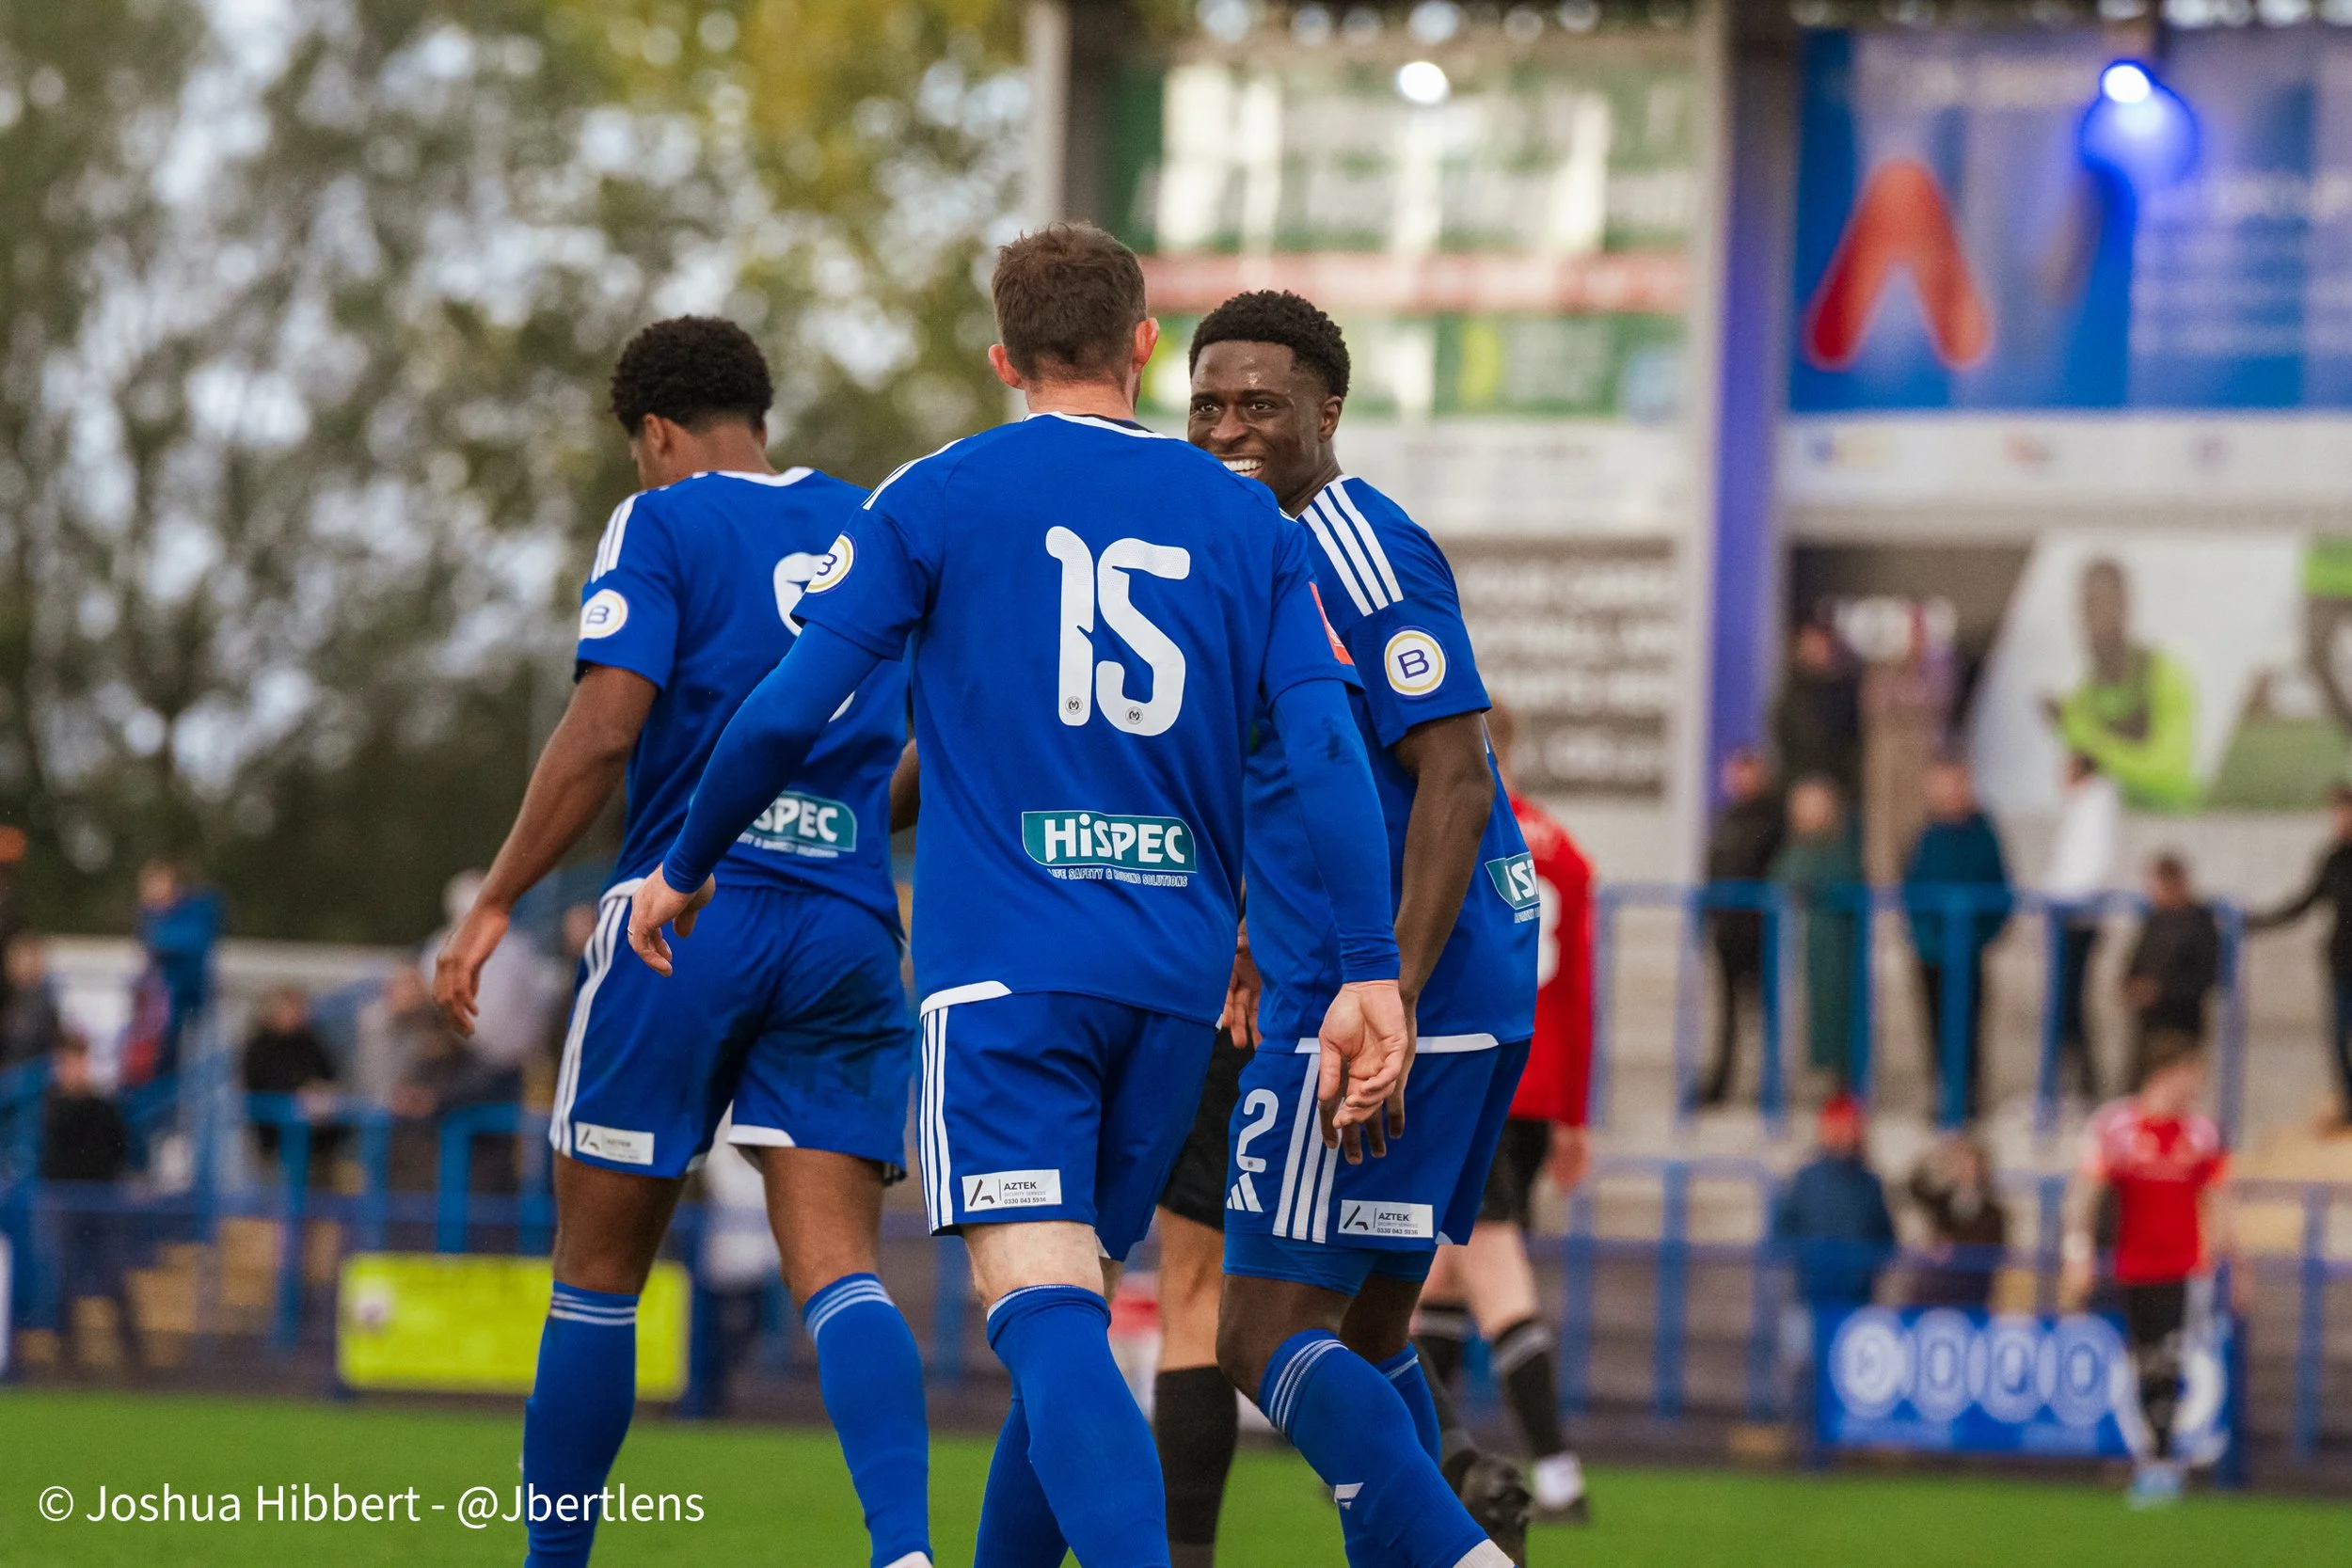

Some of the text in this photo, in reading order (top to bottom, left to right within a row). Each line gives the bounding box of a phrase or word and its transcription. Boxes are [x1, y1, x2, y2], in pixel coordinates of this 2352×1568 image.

[1045, 526, 1191, 736] 15
[1398, 649, 1429, 679] B
[753, 798, 838, 843] SPEC
[1068, 868, 1104, 880] SAFETY
[1142, 874, 1188, 887] SOLUTIONS
[1236, 1088, 1279, 1173] 2
[1003, 1181, 1037, 1191] AZTEK
[1378, 1212, 1409, 1222] AZTEK
